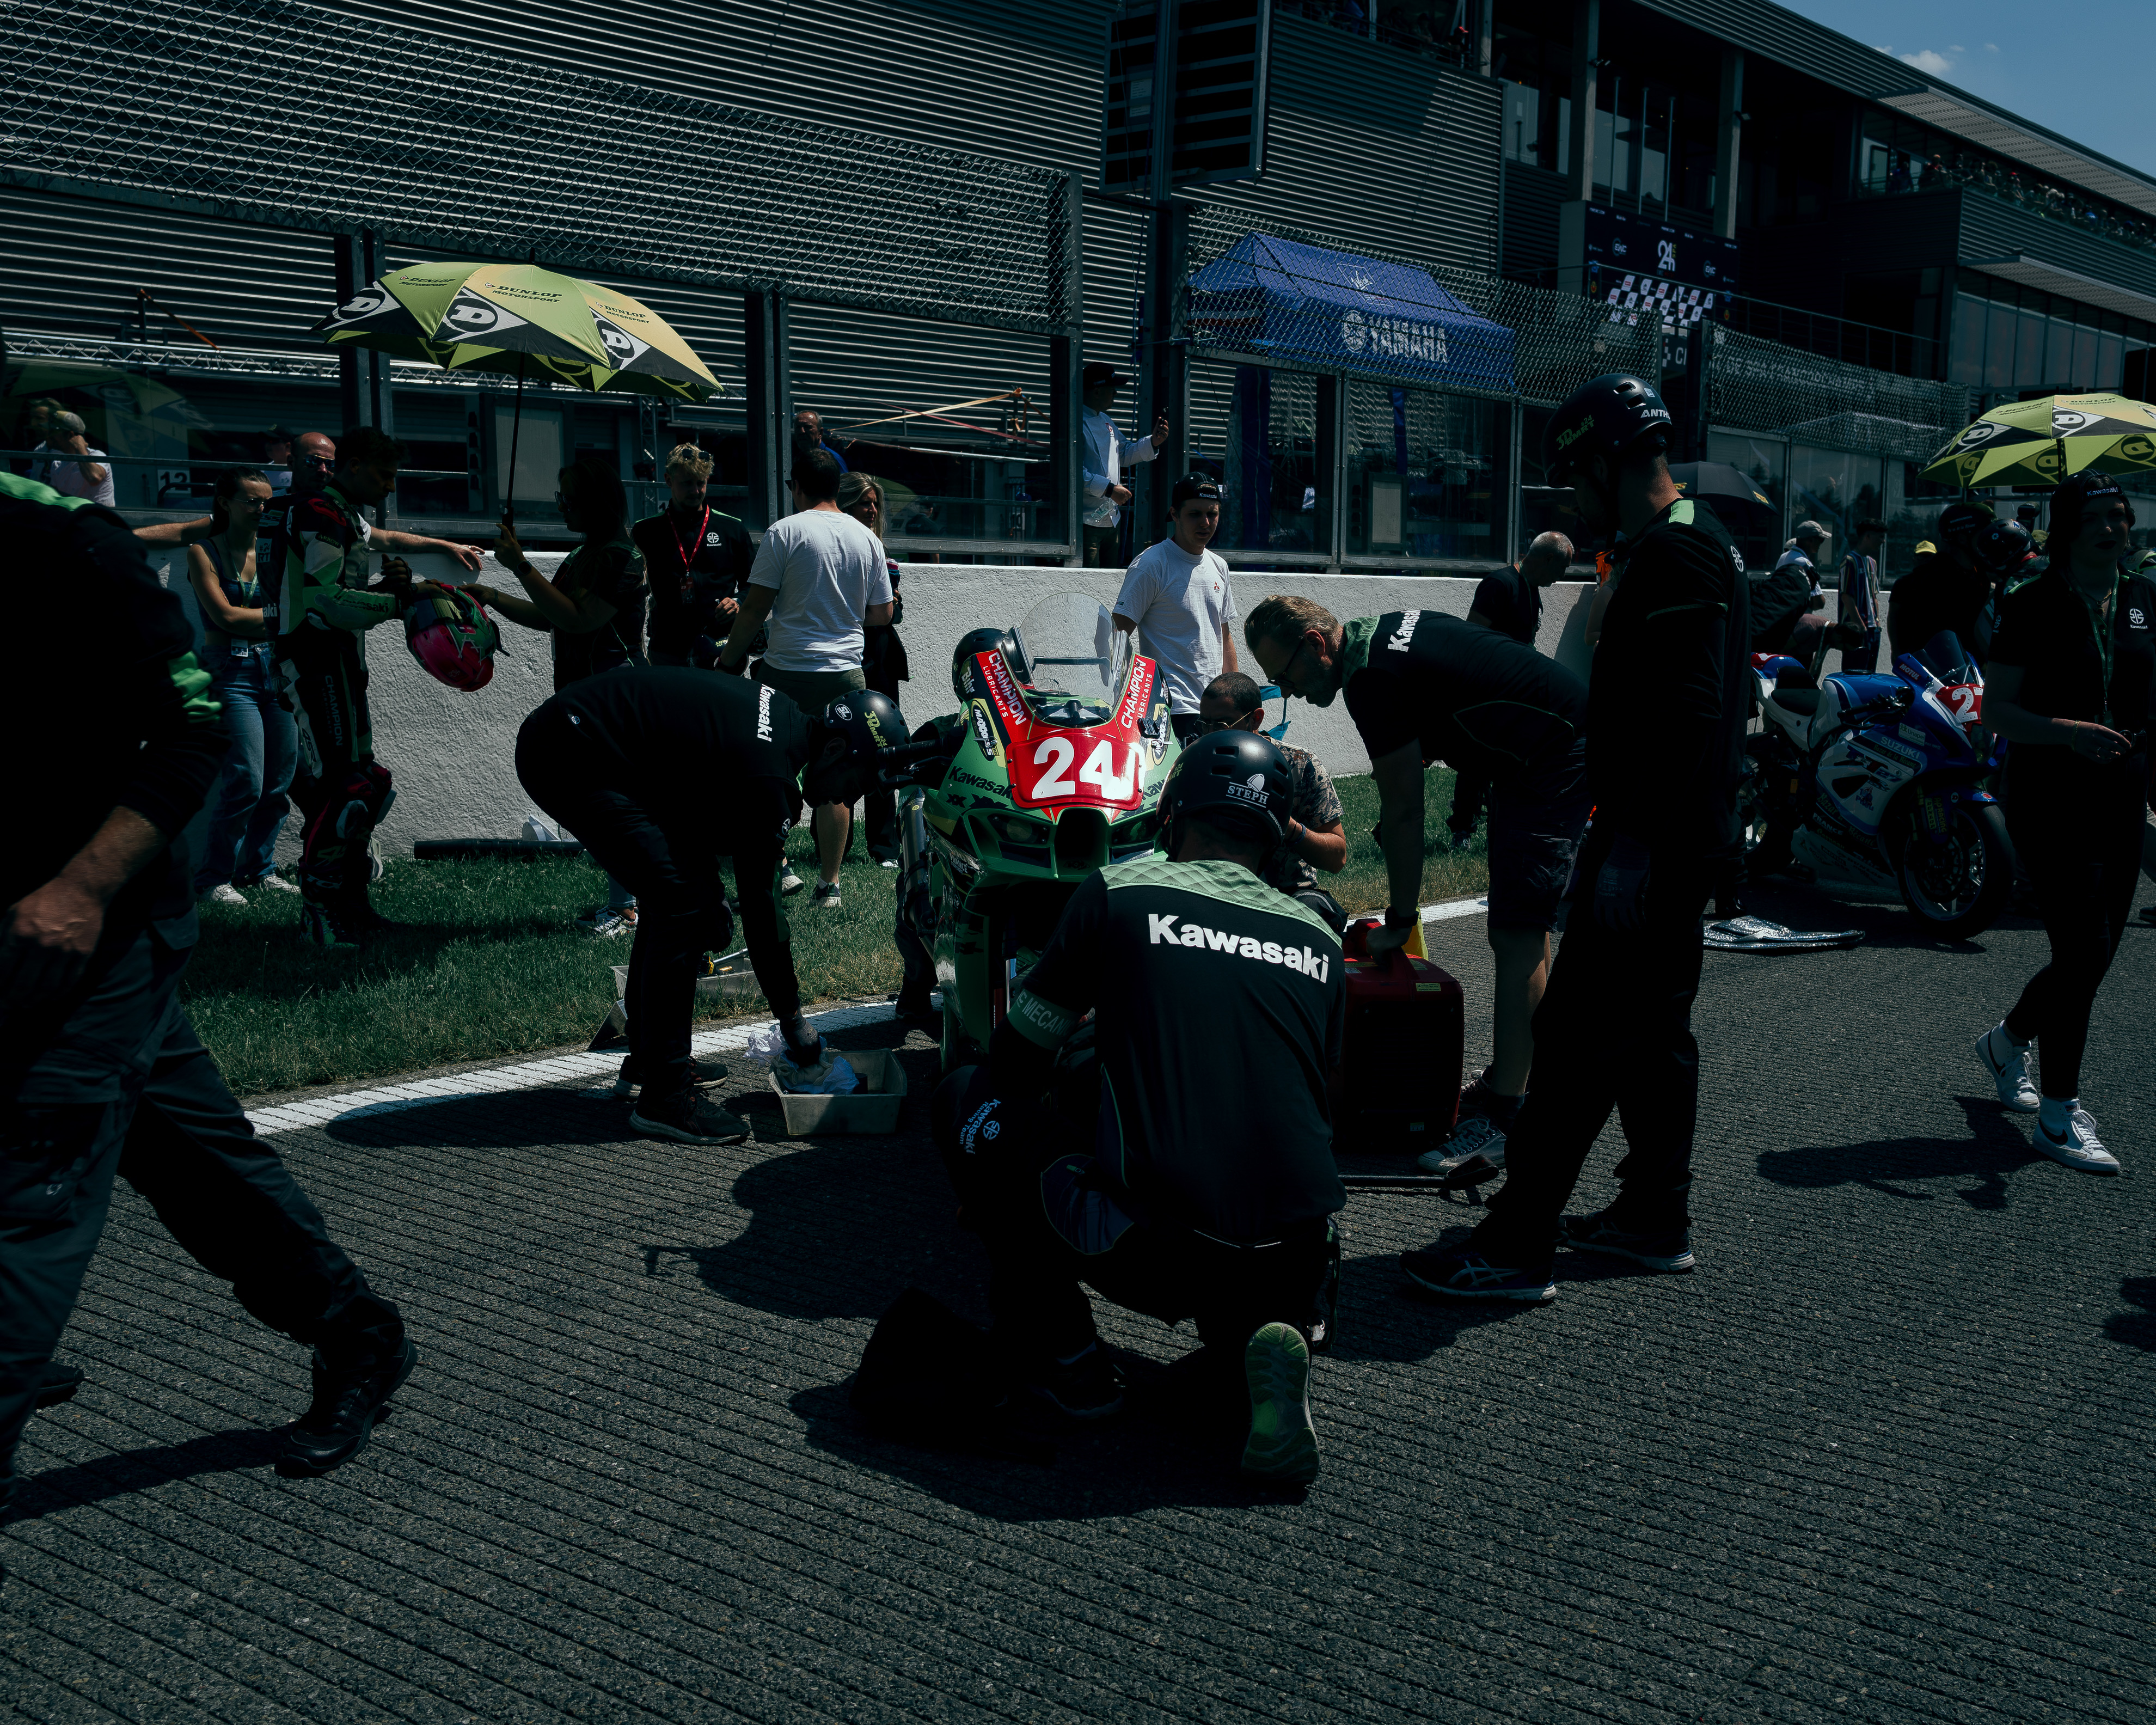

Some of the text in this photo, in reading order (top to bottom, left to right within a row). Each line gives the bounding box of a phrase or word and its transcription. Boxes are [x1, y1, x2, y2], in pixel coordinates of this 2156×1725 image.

[492, 290, 560, 303] MOTORSPORT
[496, 285, 562, 299] DUNLOP
[604, 305, 646, 318] DUNLOP
[606, 310, 650, 324] MOTORSPORT
[1368, 316, 1447, 363] YAMAHA
[2087, 487, 2118, 497] Kawasaki
[318, 534, 340, 546] ARROW
[1387, 609, 1421, 652] Kawasa
[961, 666, 975, 695] Bihr
[988, 652, 1027, 726] CHAMPION
[1899, 664, 1920, 680] MOTUL
[983, 665, 1008, 718] LUBRICANTS
[1121, 657, 1147, 729] CHAMPION
[1137, 673, 1153, 721] UBRICANTS
[325, 675, 344, 748] CHAMPION
[757, 684, 775, 742] Kawasaki
[866, 720, 883, 748] BMRT
[974, 709, 994, 756] MAXXSS
[1881, 737, 1920, 758] SUZUKI
[1908, 729, 1925, 740] Unapei
[948, 766, 1013, 800] Kawasak
[1031, 737, 1126, 800] 24
[1227, 785, 1268, 805] STEPH
[1812, 812, 1845, 836] FRANCE
[1937, 808, 1947, 833] RACING
[1148, 914, 1329, 984] Kawasaki
[1022, 997, 1070, 1036] MECAN
[959, 1101, 989, 1145] Racing Team
[965, 1098, 1001, 1155] Kawasaki
